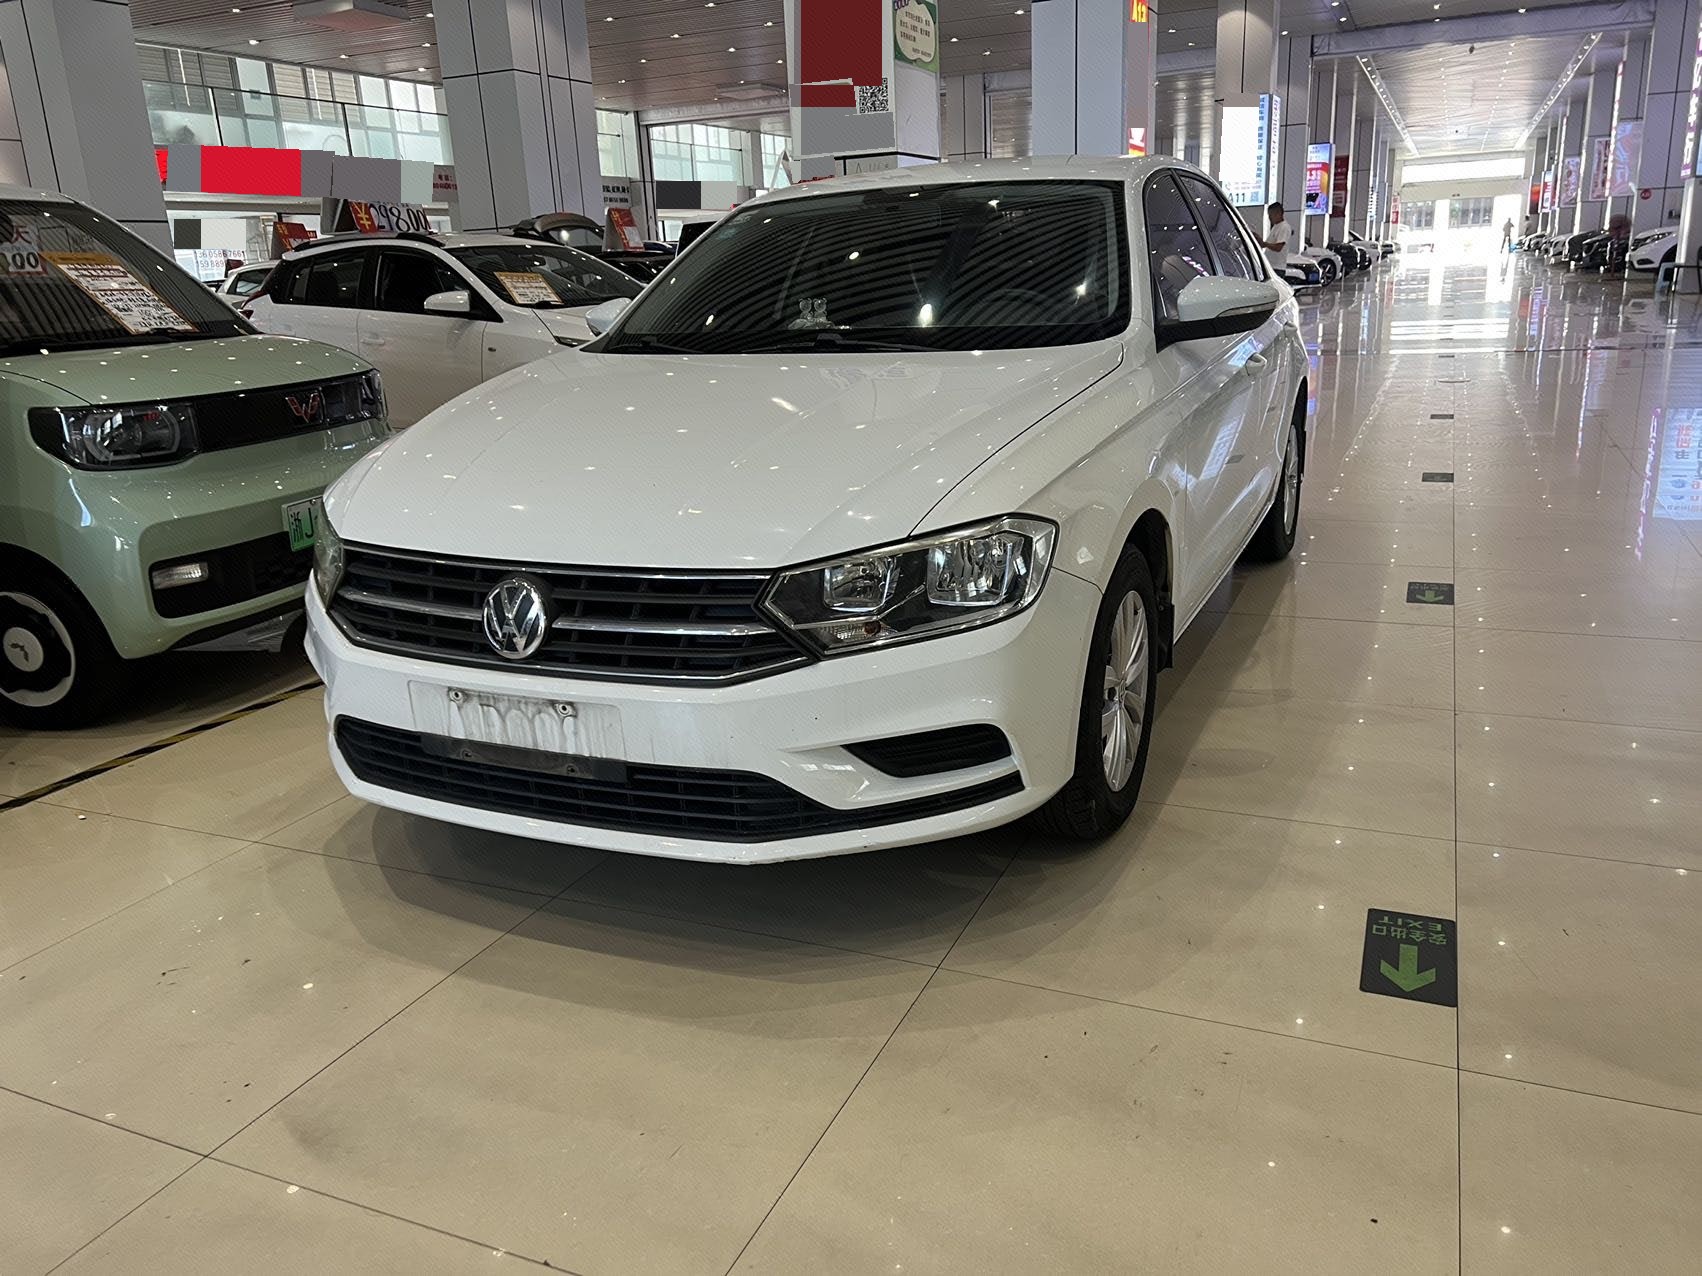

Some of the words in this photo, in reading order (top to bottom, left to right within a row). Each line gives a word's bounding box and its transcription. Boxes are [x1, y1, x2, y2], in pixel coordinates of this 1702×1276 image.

[1378, 915, 1442, 931] EXIT
[1372, 924, 1447, 945] 安全出口
